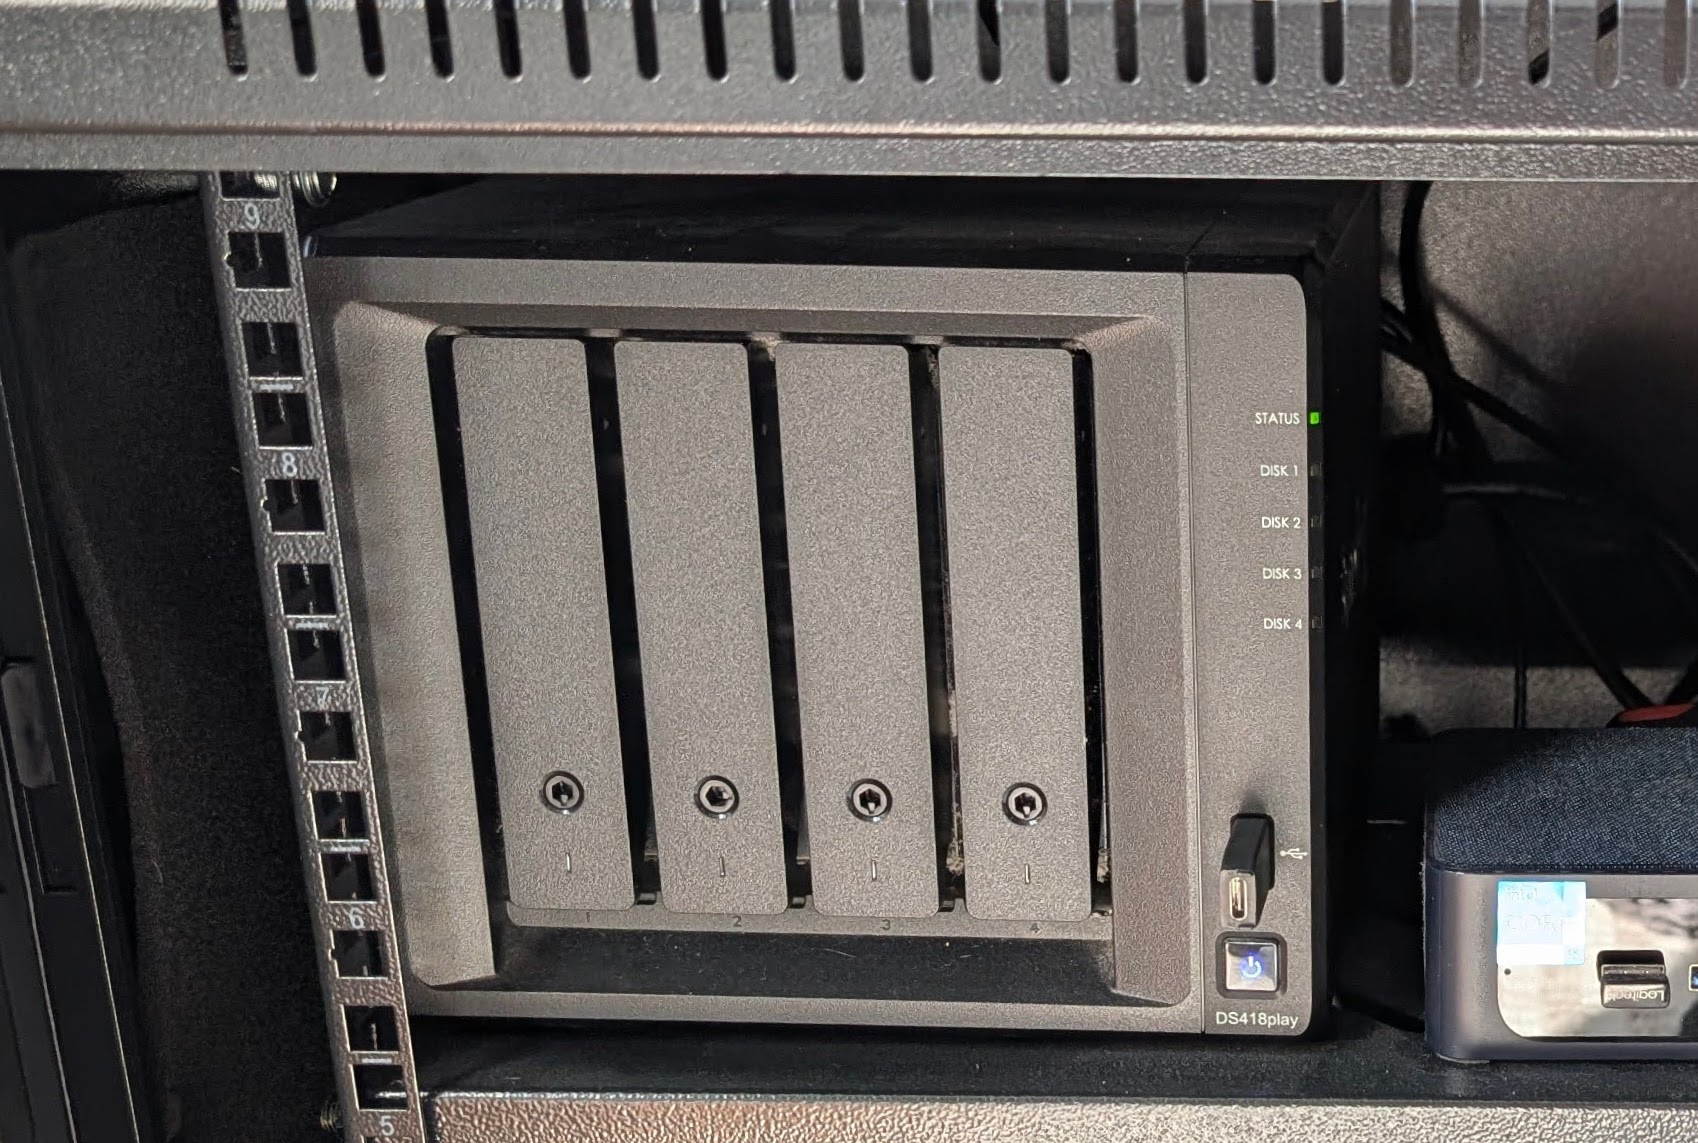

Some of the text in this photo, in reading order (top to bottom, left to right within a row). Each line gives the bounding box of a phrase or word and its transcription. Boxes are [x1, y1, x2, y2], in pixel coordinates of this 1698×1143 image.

[244, 203, 260, 229] 9
[1255, 412, 1300, 425] STATUS
[282, 452, 297, 477] 8
[1261, 464, 1298, 477] DISK 1
[1262, 516, 1301, 529] DISK 2
[1262, 567, 1302, 580] DISK 3
[1264, 618, 1302, 630] DISK 4
[316, 686, 329, 706] 7
[350, 907, 364, 929] 6
[1216, 1011, 1299, 1029] DS418play
[380, 1115, 394, 1136] 5
